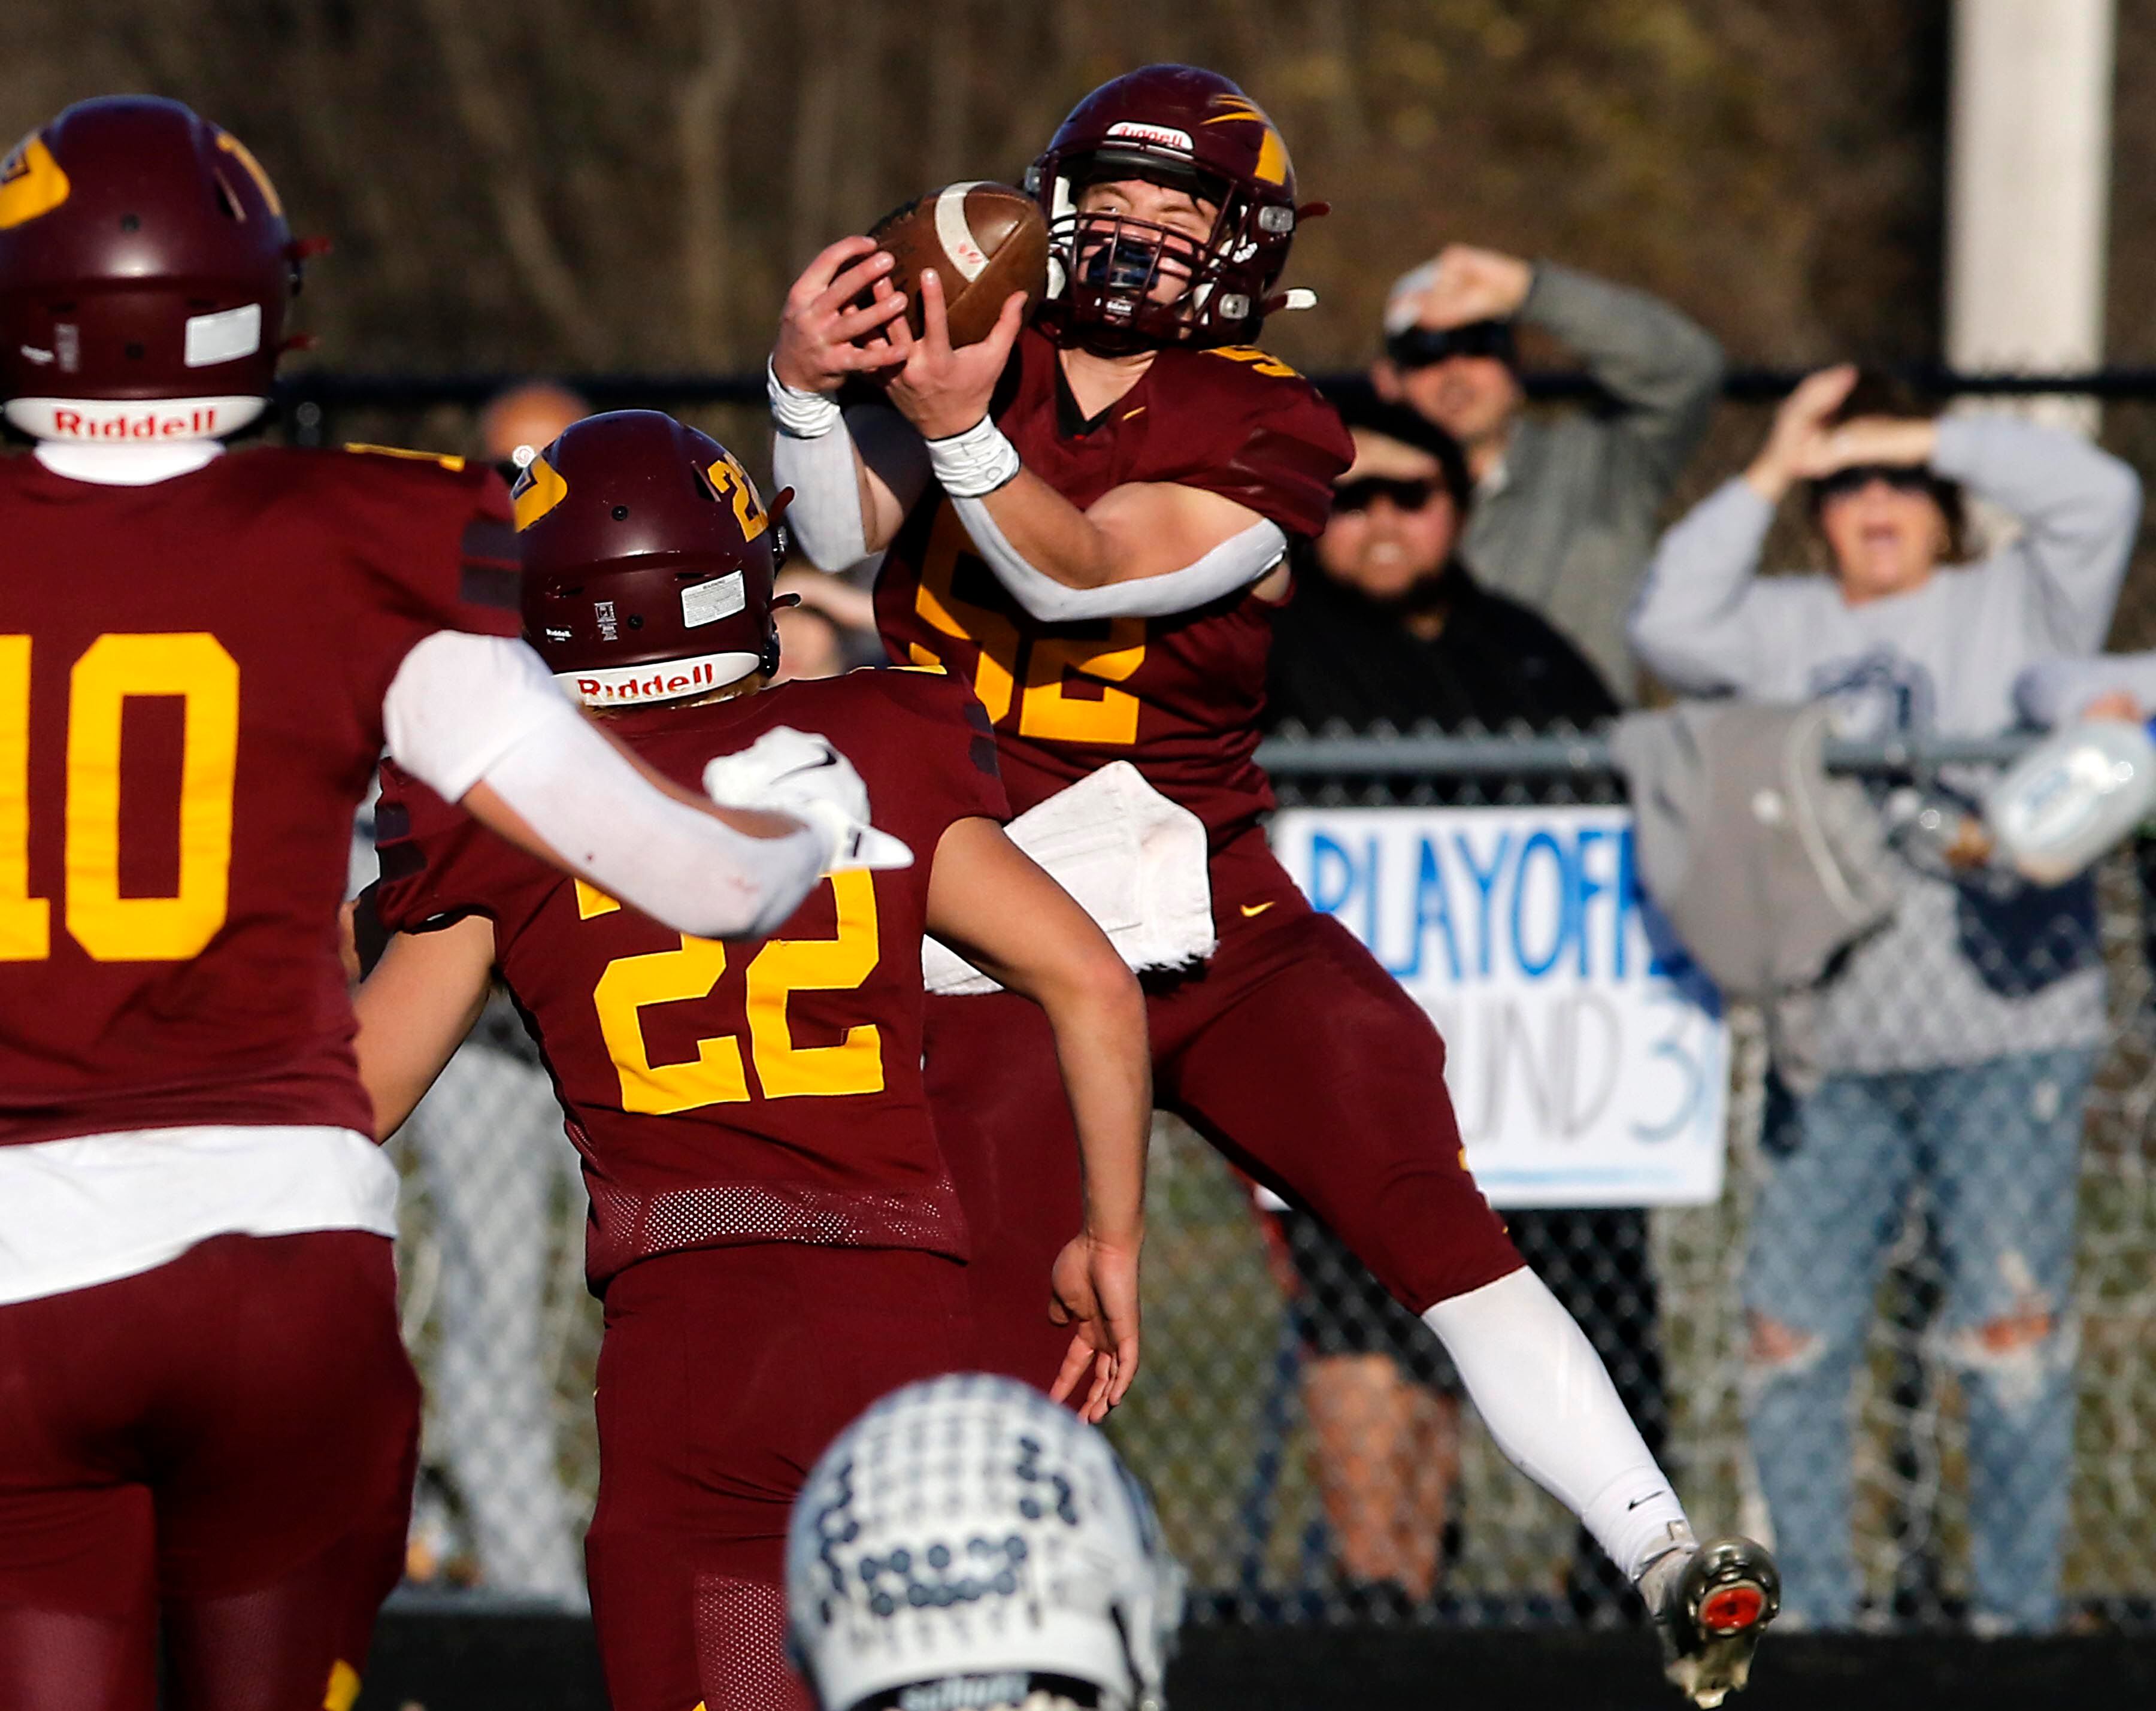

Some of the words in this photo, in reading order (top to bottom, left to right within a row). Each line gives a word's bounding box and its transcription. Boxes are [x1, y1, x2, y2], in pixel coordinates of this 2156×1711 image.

[55, 409, 216, 437] Riddell
[577, 663, 713, 698] Riddell
[0, 632, 240, 962] 10
[1313, 829, 1671, 981] PLAYOFF
[574, 865, 885, 1115] 22
[1434, 991, 1623, 1143] UND
